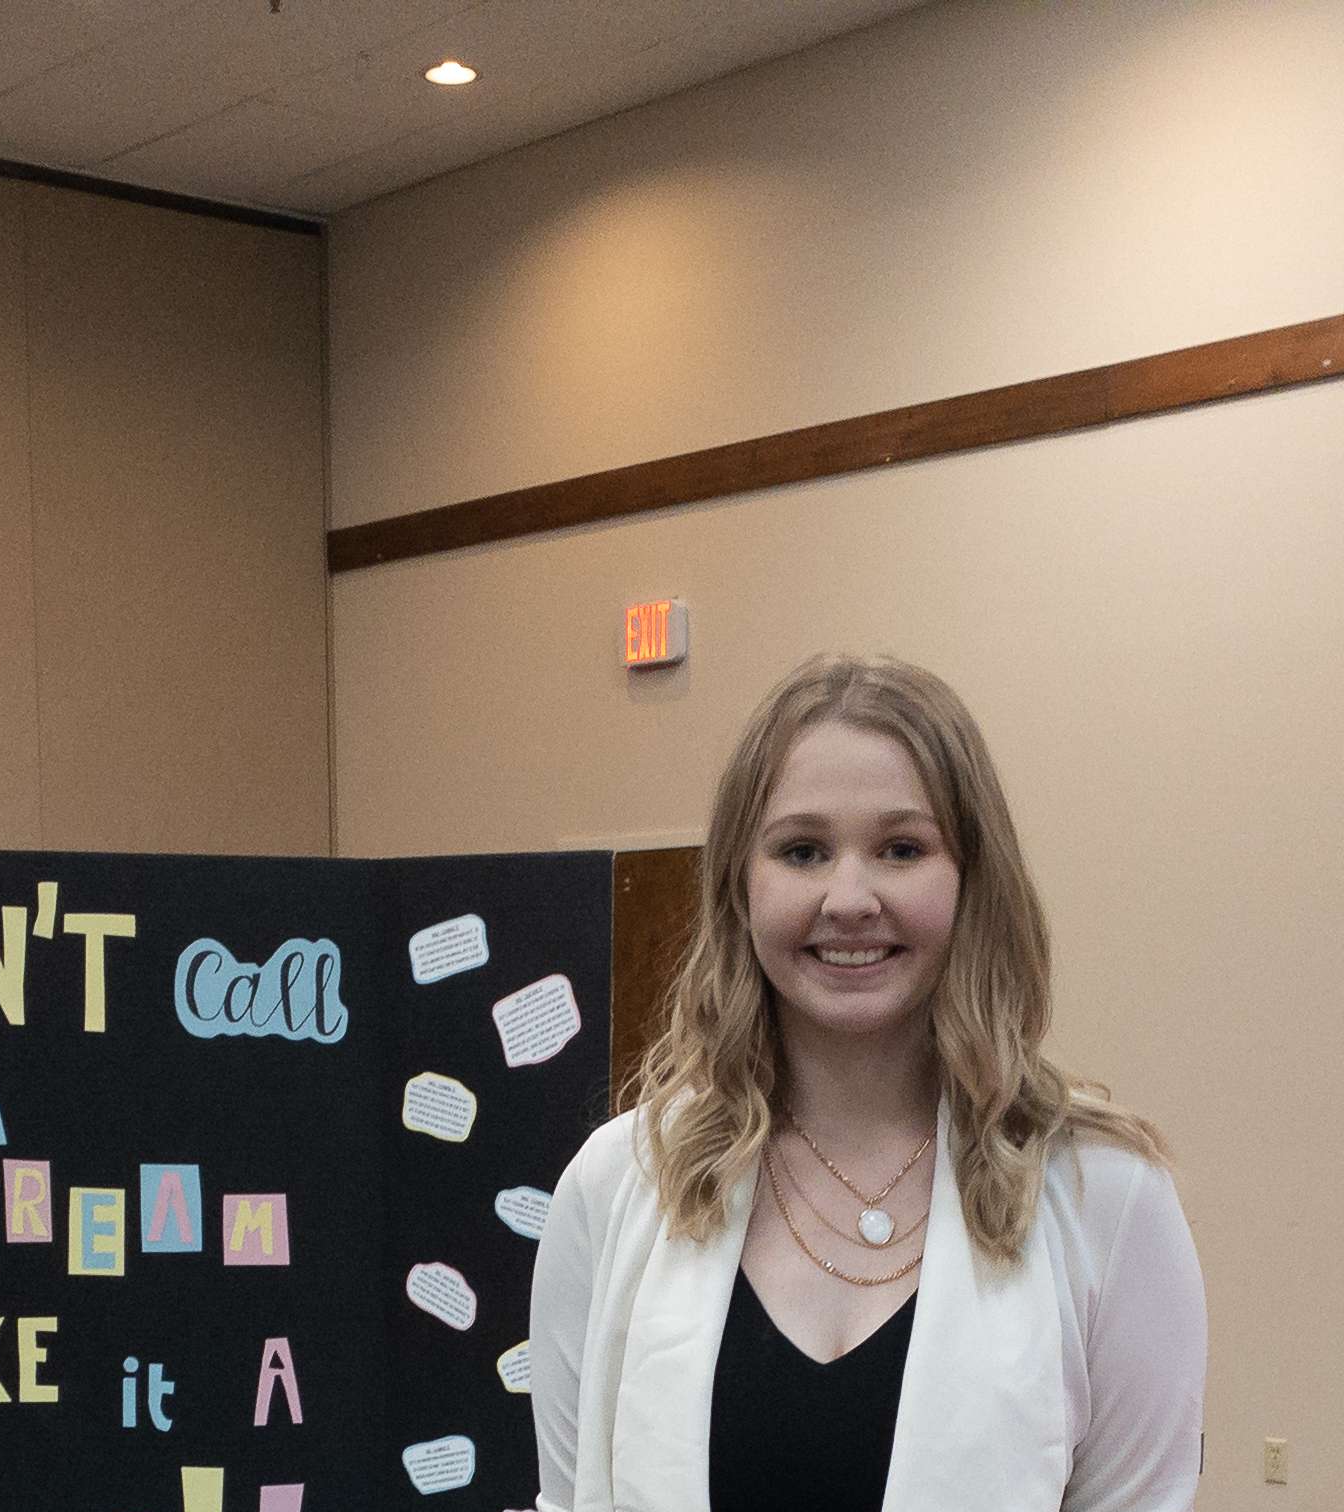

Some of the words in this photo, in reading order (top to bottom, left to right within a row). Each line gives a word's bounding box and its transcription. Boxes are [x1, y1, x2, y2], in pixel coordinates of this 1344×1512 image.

[625, 601, 671, 661] EXIT
[122, 1356, 174, 1432] it
[254, 1337, 303, 1426] A
